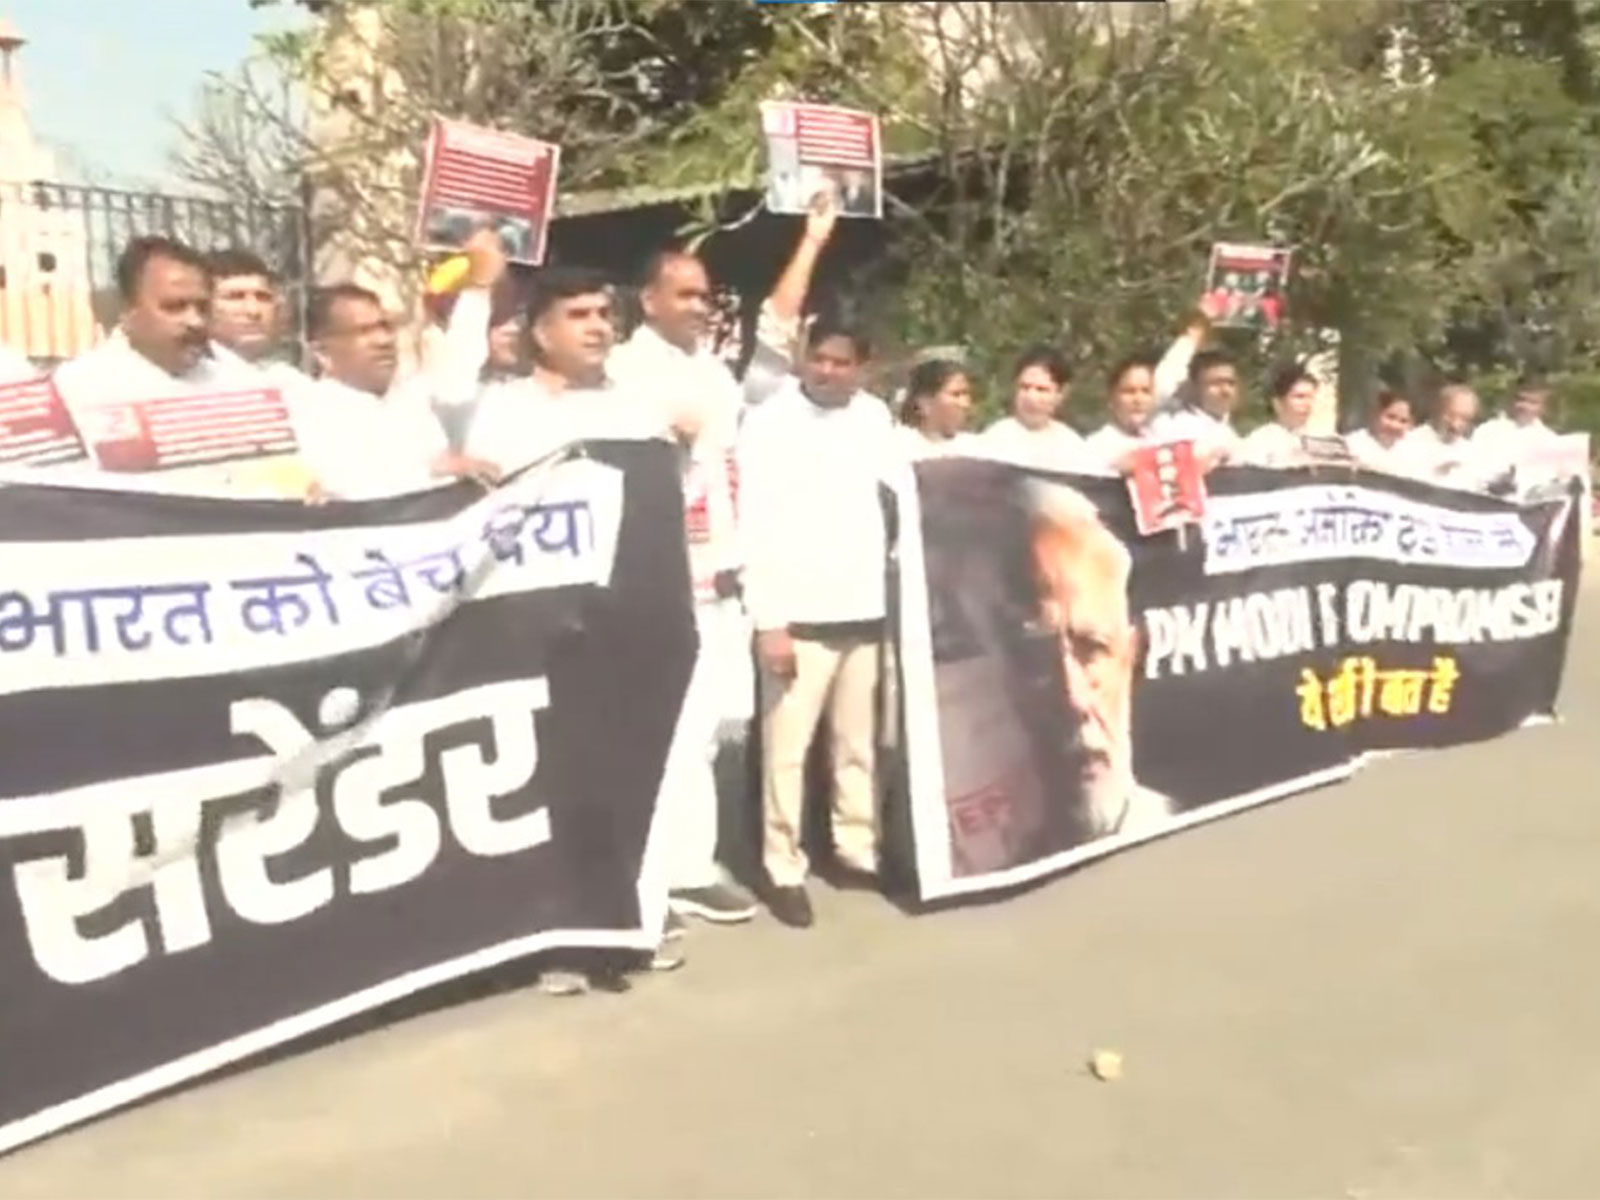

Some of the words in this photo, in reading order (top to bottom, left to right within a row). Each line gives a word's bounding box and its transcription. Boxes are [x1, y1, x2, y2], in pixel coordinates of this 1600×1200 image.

[0, 582, 211, 656] भारत
[229, 552, 340, 635] को
[350, 548, 467, 610] बेच
[1143, 602, 1209, 680] PM
[1212, 585, 1315, 667] MODI
[0, 676, 552, 984] सरेंडर
